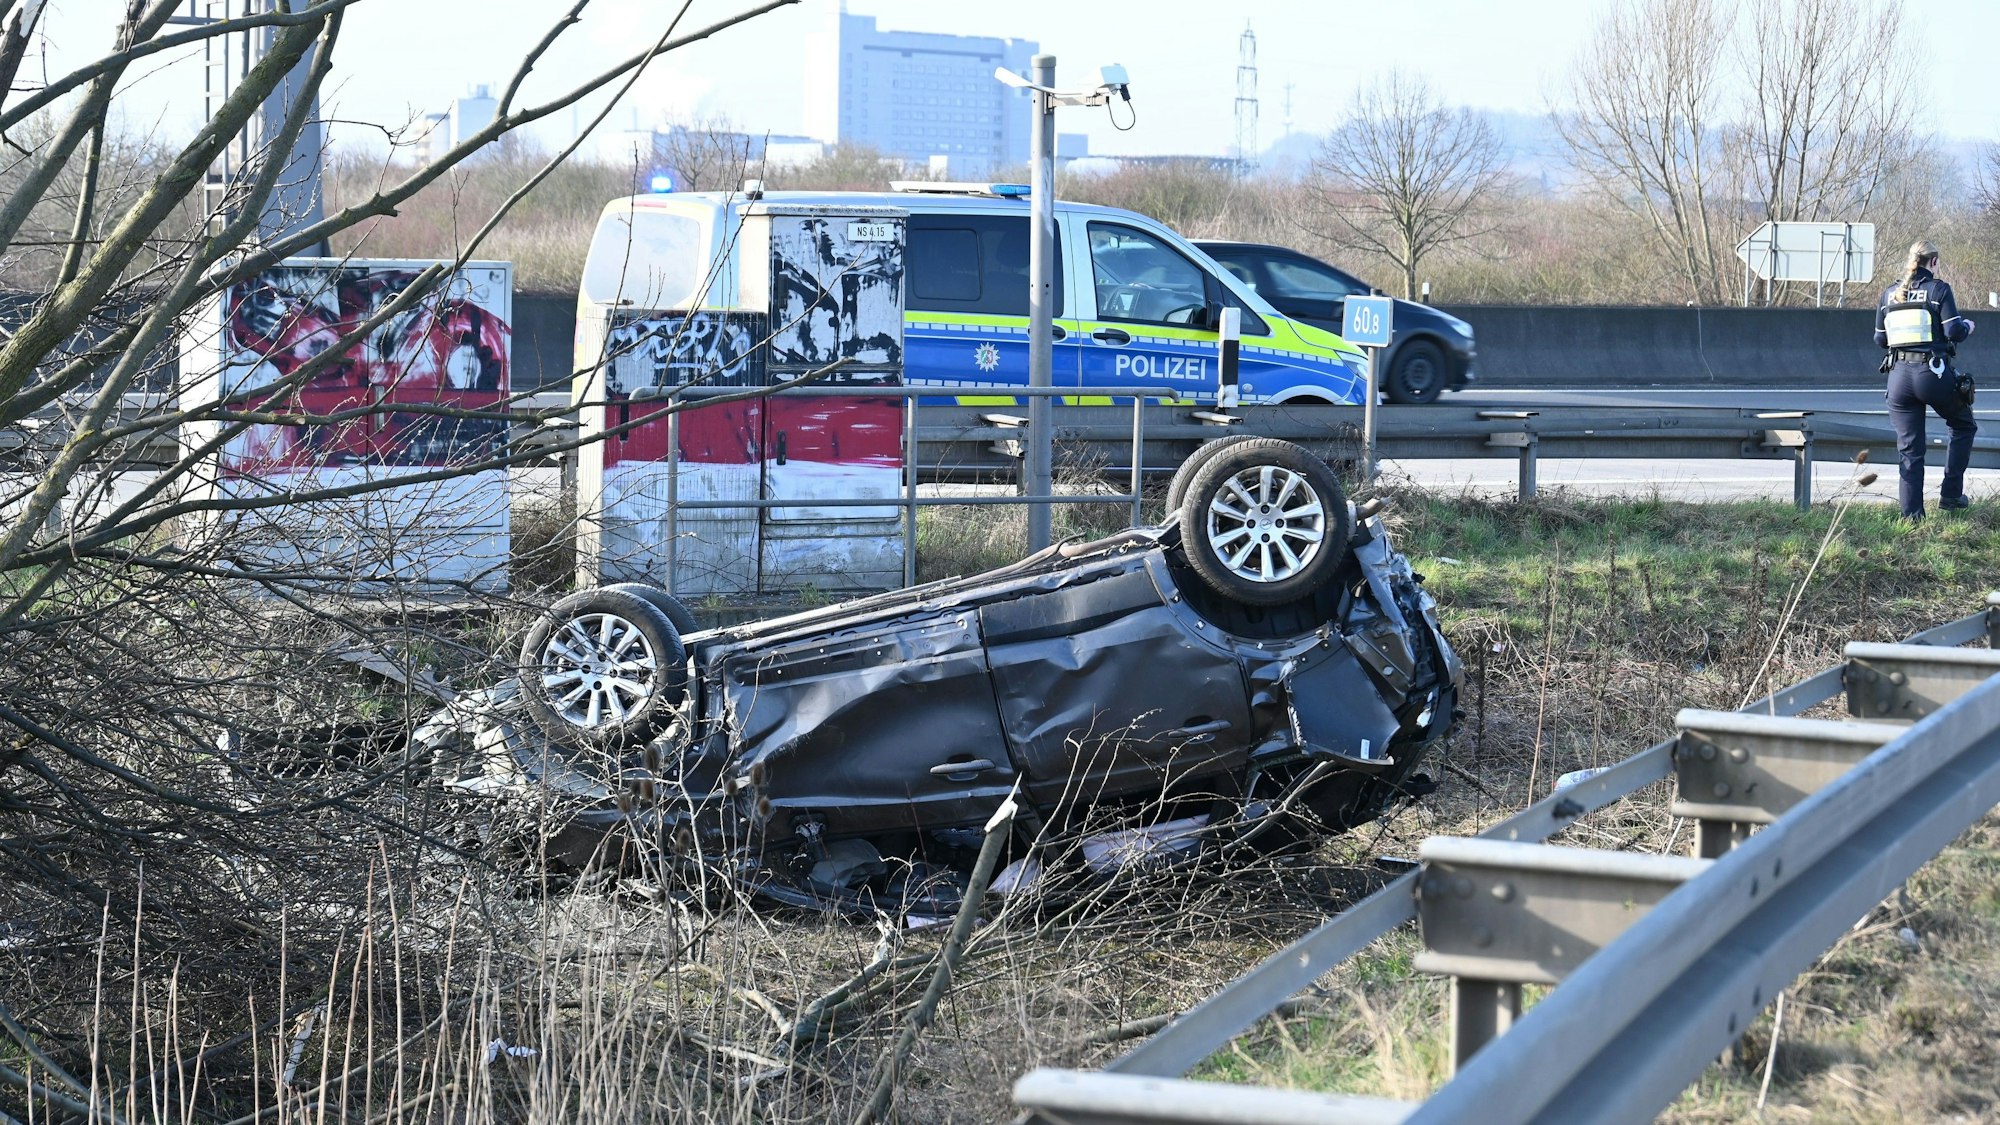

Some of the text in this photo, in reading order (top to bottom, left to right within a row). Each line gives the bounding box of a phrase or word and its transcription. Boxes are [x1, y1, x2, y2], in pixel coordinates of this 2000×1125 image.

[857, 226, 885, 237] NS 4.15
[1887, 289, 1928, 306] PIZEI
[1353, 305, 1380, 335] 60.8
[1115, 353, 1207, 381] POLIZEI
